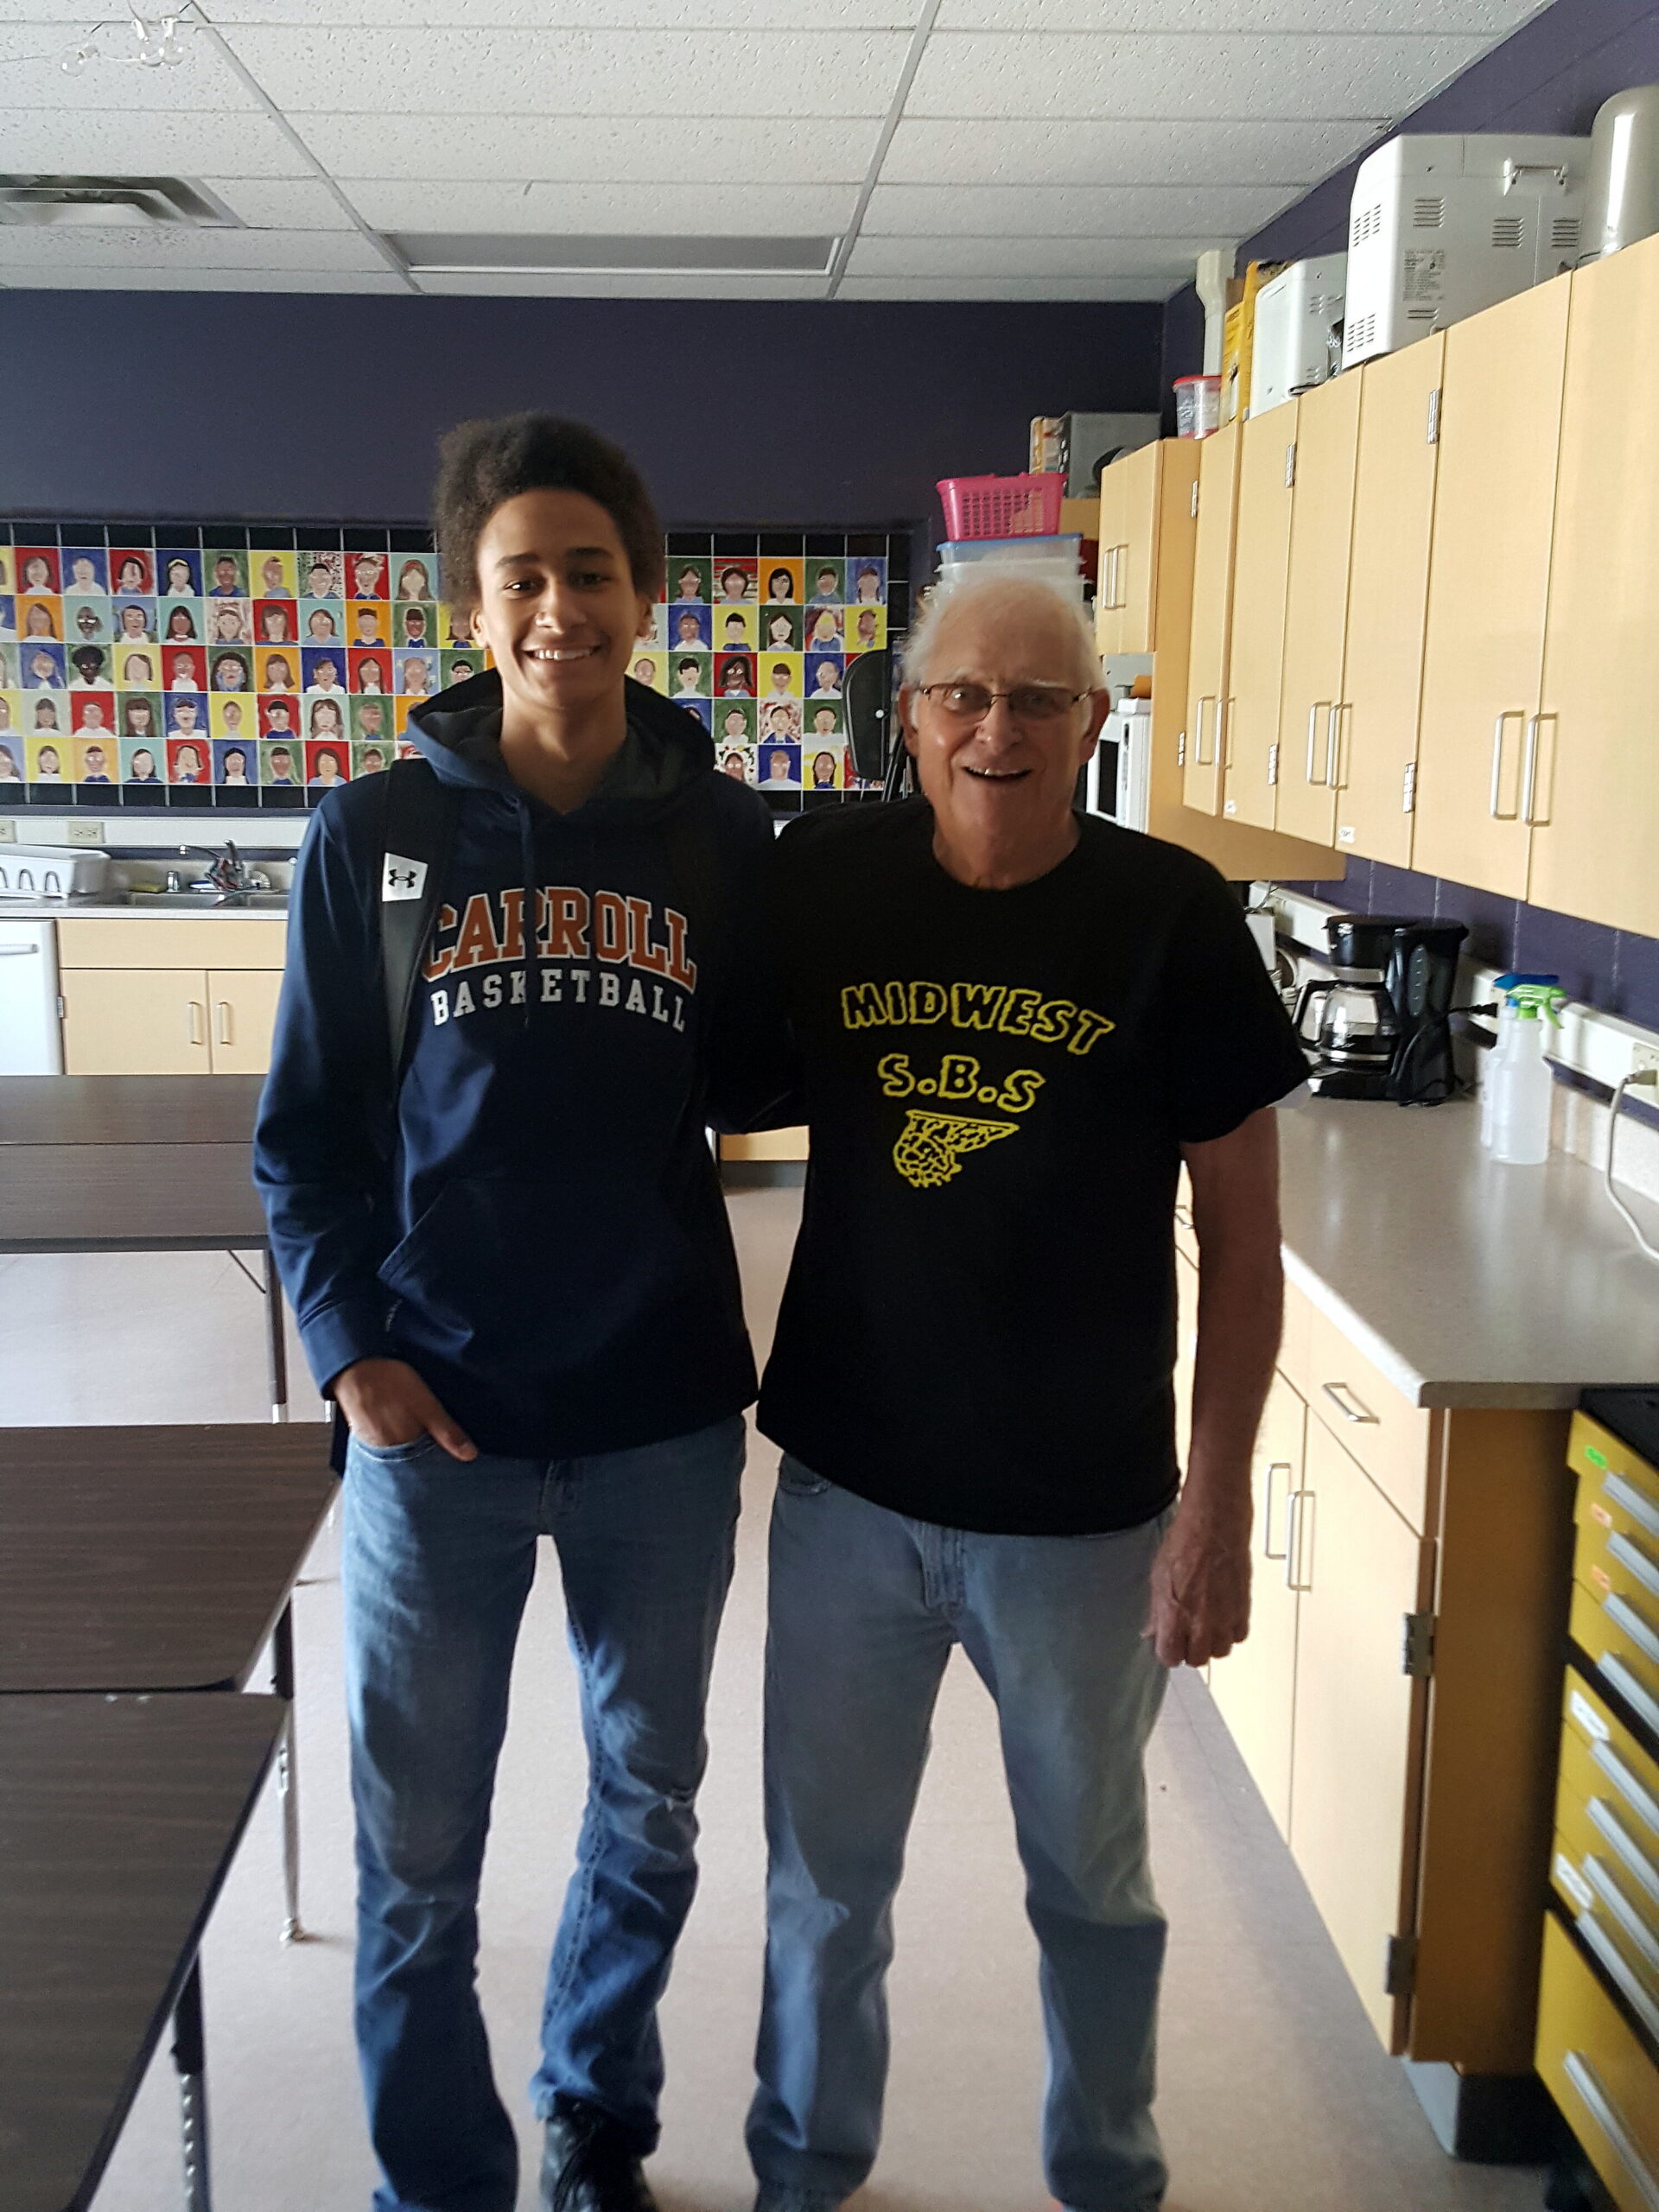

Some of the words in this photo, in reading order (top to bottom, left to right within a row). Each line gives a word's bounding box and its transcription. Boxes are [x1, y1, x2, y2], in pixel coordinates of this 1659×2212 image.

[422, 886, 697, 995] CARROLL
[430, 968, 685, 1033] BASKETBALL
[841, 981, 1116, 1055] MIDWEST
[877, 1052, 1046, 1113] S.B.S
